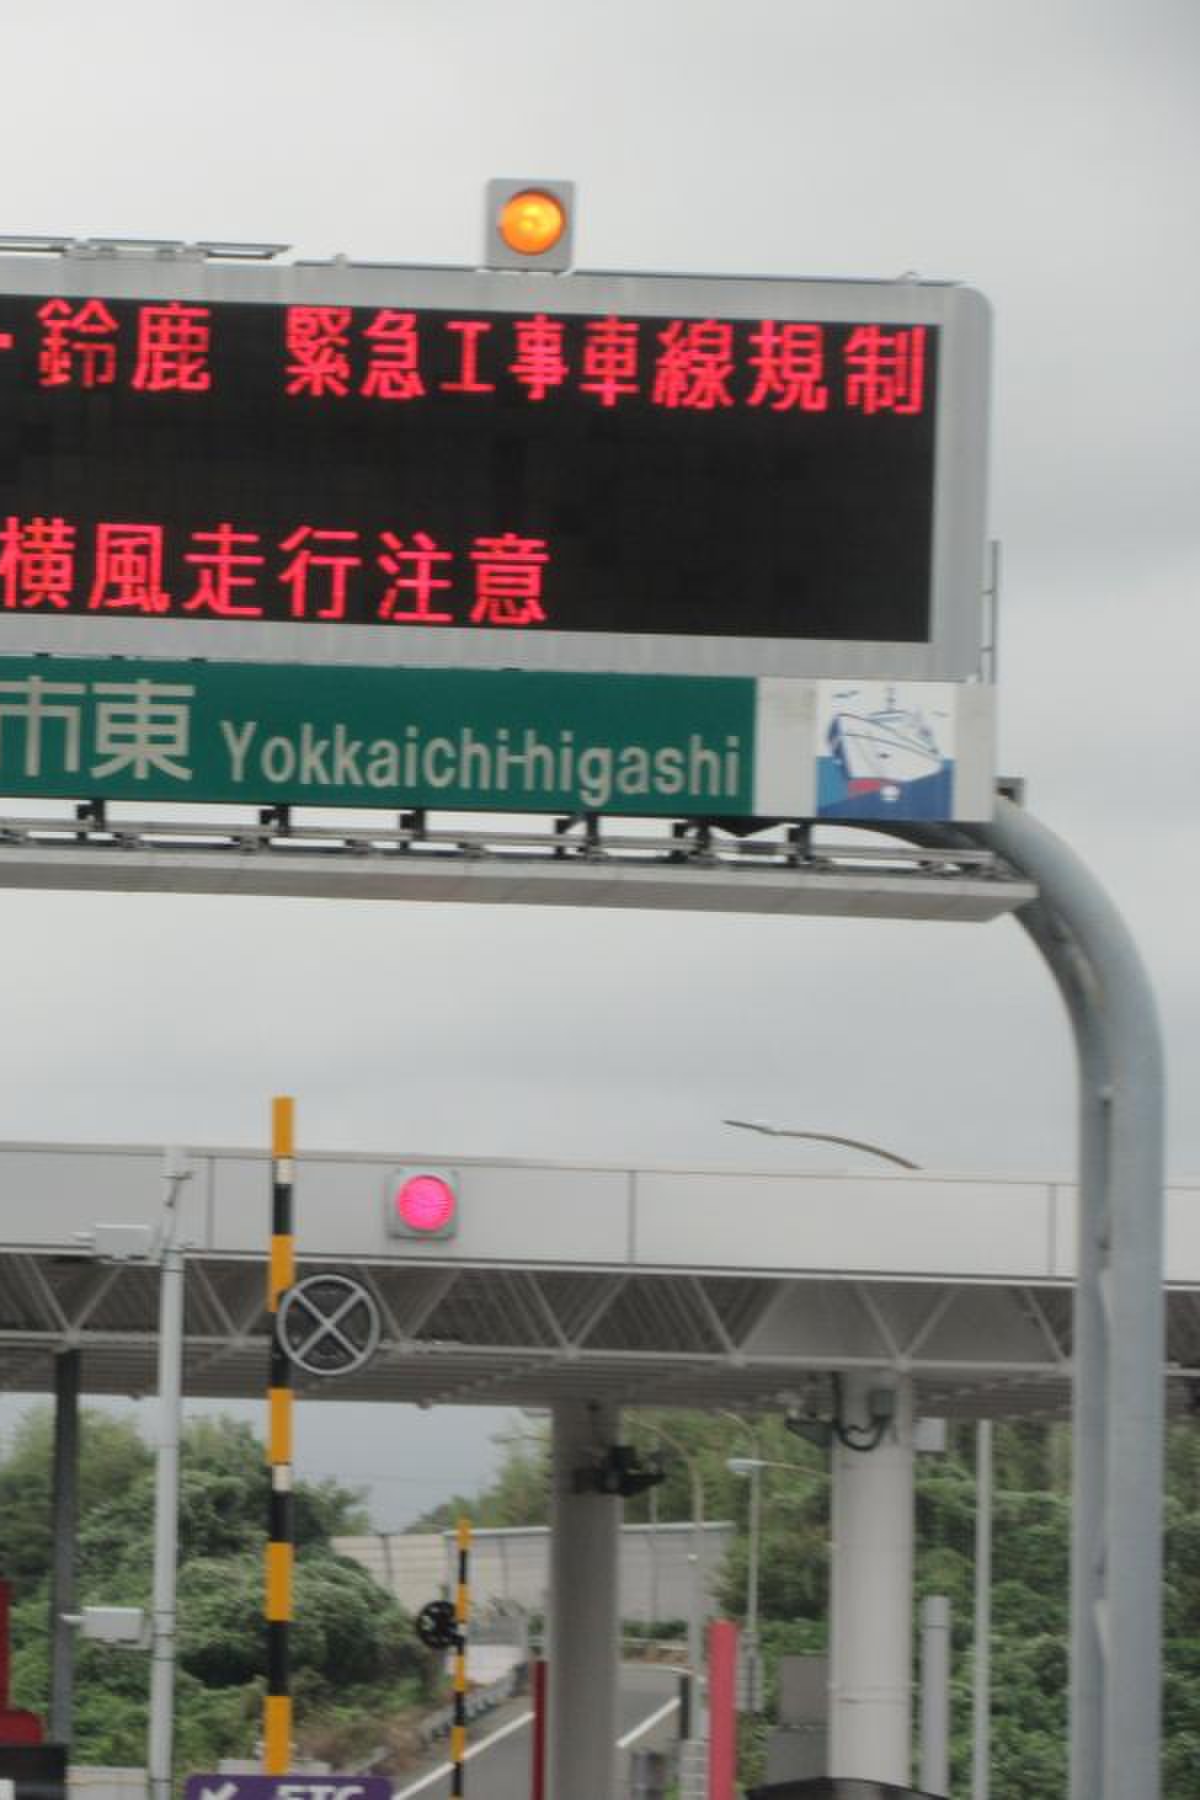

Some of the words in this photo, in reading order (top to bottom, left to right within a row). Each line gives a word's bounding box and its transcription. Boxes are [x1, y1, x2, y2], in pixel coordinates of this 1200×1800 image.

[284, 304, 928, 417] 緊急工事車線規制
[221, 720, 741, 807] Yokkaichi-higashi
